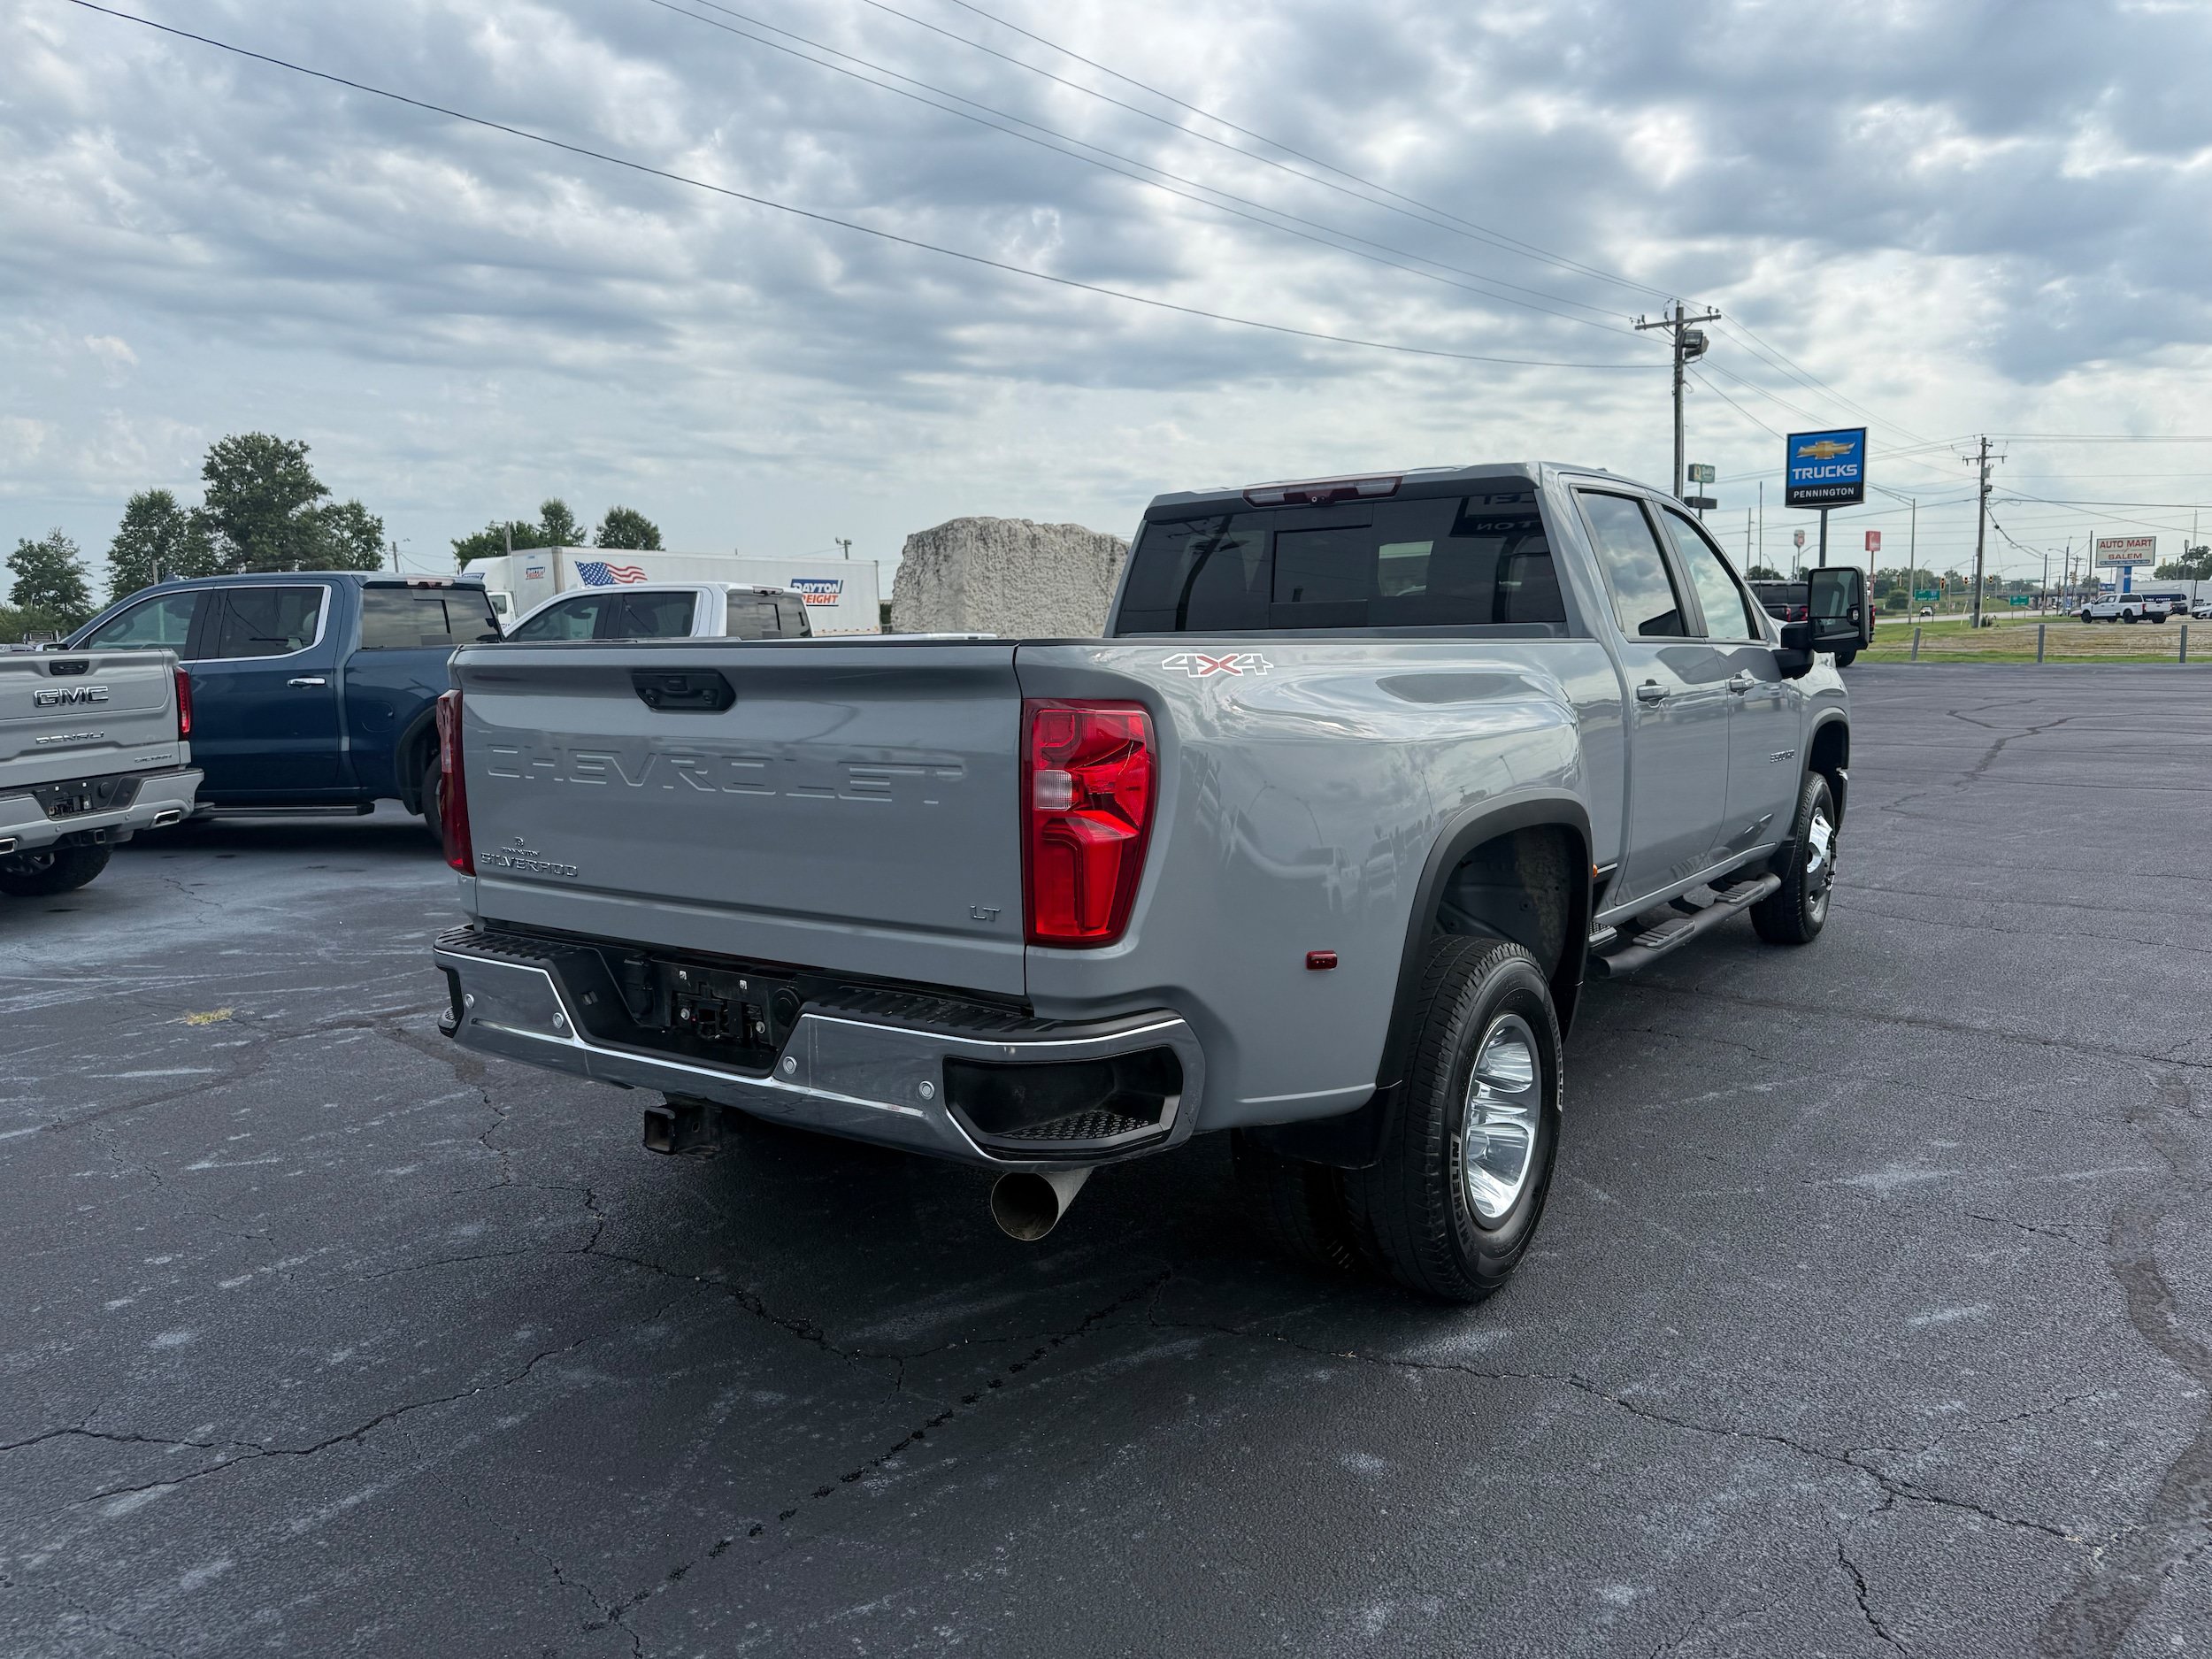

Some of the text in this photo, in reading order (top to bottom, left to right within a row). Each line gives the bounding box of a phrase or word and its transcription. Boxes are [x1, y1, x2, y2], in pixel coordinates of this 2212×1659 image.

[1793, 464, 1858, 480] TRUCKS
[1793, 488, 1855, 498] PENNINGTON
[801, 594, 839, 604] EIGHT
[34, 686, 109, 708] GMC
[488, 742, 964, 805] CHEVROLET
[480, 852, 578, 877] SILVERADO
[970, 905, 1001, 922] LT
[1451, 1141, 1471, 1245] MICHELIN
